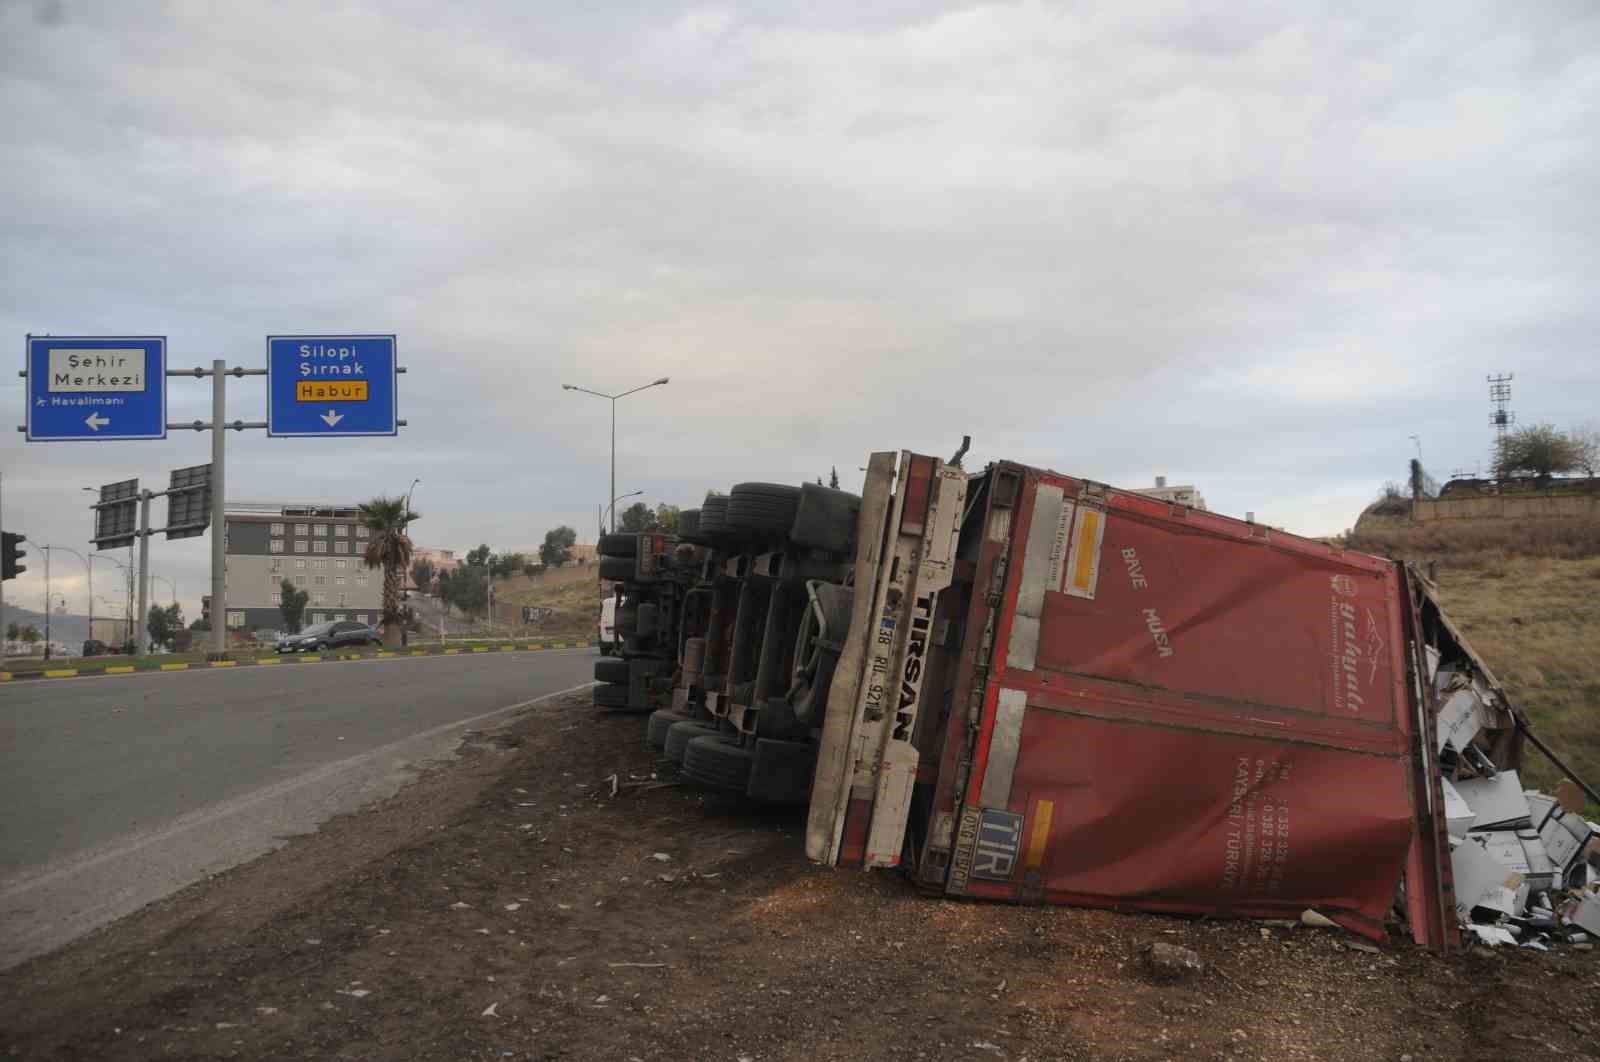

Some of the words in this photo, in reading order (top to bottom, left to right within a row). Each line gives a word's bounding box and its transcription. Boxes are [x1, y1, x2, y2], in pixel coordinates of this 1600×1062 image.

[300, 345, 356, 360] Silopi
[68, 354, 127, 369] Şehir
[300, 362, 364, 376] Şırnak
[55, 373, 140, 386] Merkezi
[302, 385, 362, 397] Habur
[1121, 547, 1147, 591] BAVE
[1142, 608, 1173, 658] MUSA
[892, 592, 934, 742] TIRSAN
[974, 820, 1020, 873] TIR
